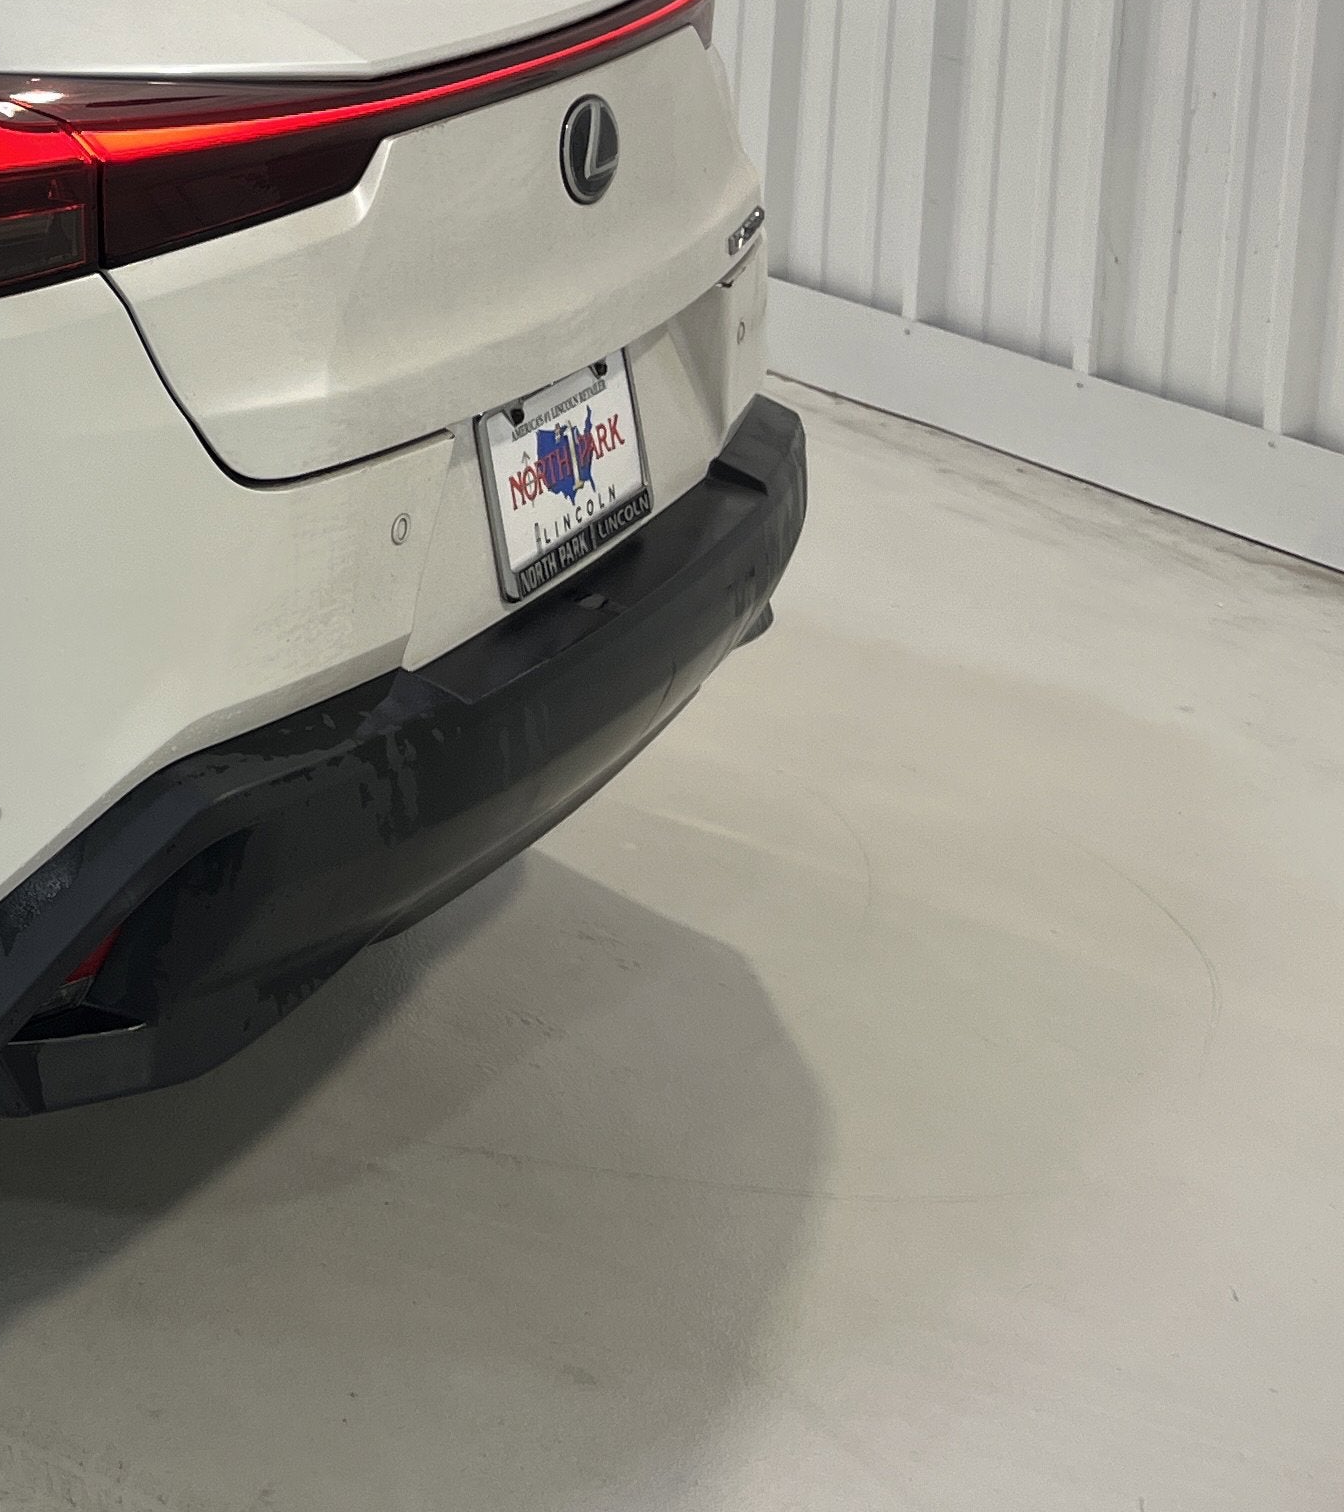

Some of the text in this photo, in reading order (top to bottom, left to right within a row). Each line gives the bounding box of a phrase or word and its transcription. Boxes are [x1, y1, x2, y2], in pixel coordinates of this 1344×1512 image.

[508, 413, 626, 511] NORTH PARK
[519, 492, 651, 598] NORTH PARK LINCOLN
[543, 484, 616, 544] LINCOLN
